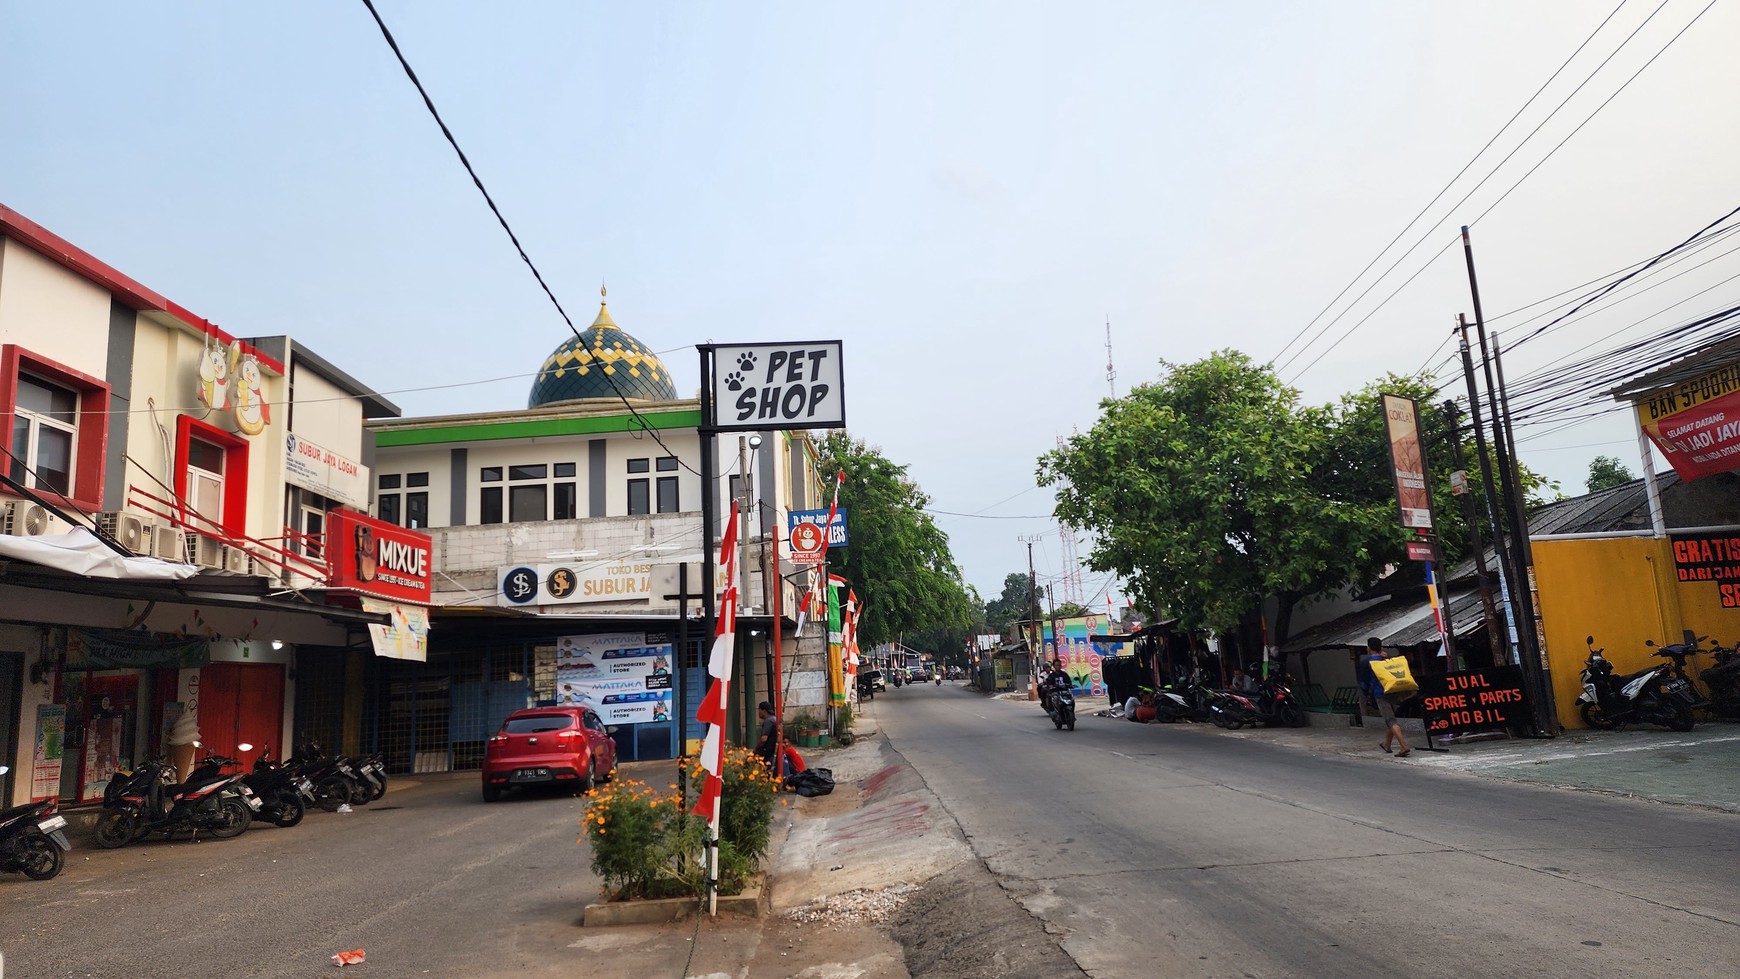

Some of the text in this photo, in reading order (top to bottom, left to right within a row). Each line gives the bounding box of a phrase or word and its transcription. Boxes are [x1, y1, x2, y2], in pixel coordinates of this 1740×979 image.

[766, 349, 827, 384] PET
[735, 384, 829, 421] SHOP
[1648, 391, 1677, 419] BAN
[1667, 412, 1724, 438] SELAMAT DATANG
[1687, 430, 1715, 450] JADI
[1717, 420, 1740, 442] JAY
[299, 442, 321, 461] SUBUR
[323, 452, 336, 468] JAYA
[338, 459, 358, 477] LOGAM
[379, 538, 427, 577] MIXUE
[1673, 538, 1740, 563] GRATIS
[607, 563, 650, 575] TOKO BES
[1678, 567, 1712, 580] DARI
[584, 577, 637, 596] SUBUR
[592, 636, 642, 645] MATTAKA
[592, 681, 642, 690] MATTAKA
[1446, 674, 1491, 691] JUAL
[1424, 688, 1522, 711] SPARE PARTS
[1451, 709, 1505, 726] MOBIL
